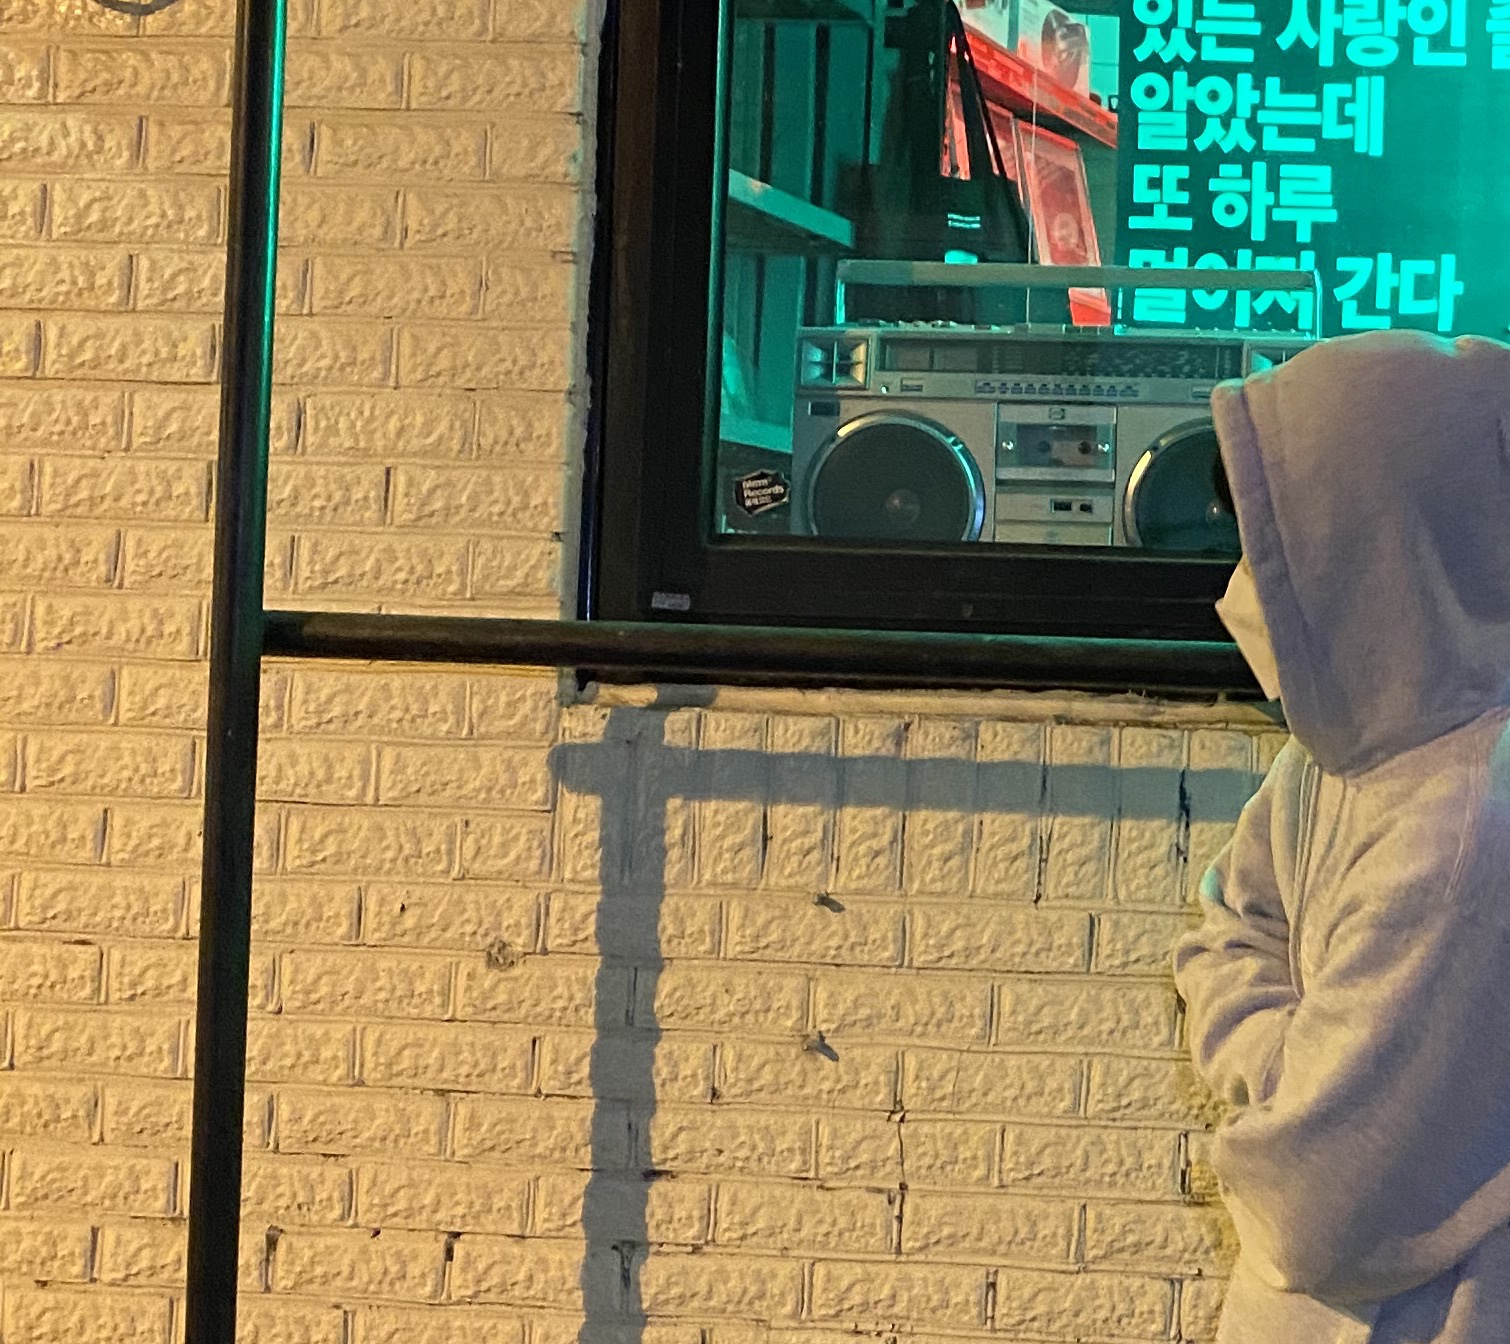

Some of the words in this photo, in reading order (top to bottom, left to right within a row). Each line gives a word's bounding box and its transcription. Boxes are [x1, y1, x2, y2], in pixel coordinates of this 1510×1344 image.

[1130, 71, 1385, 157] 알았는데
[1128, 164, 1193, 231] 또
[1208, 161, 1338, 243] 하루
[1333, 252, 1465, 332] 간다
